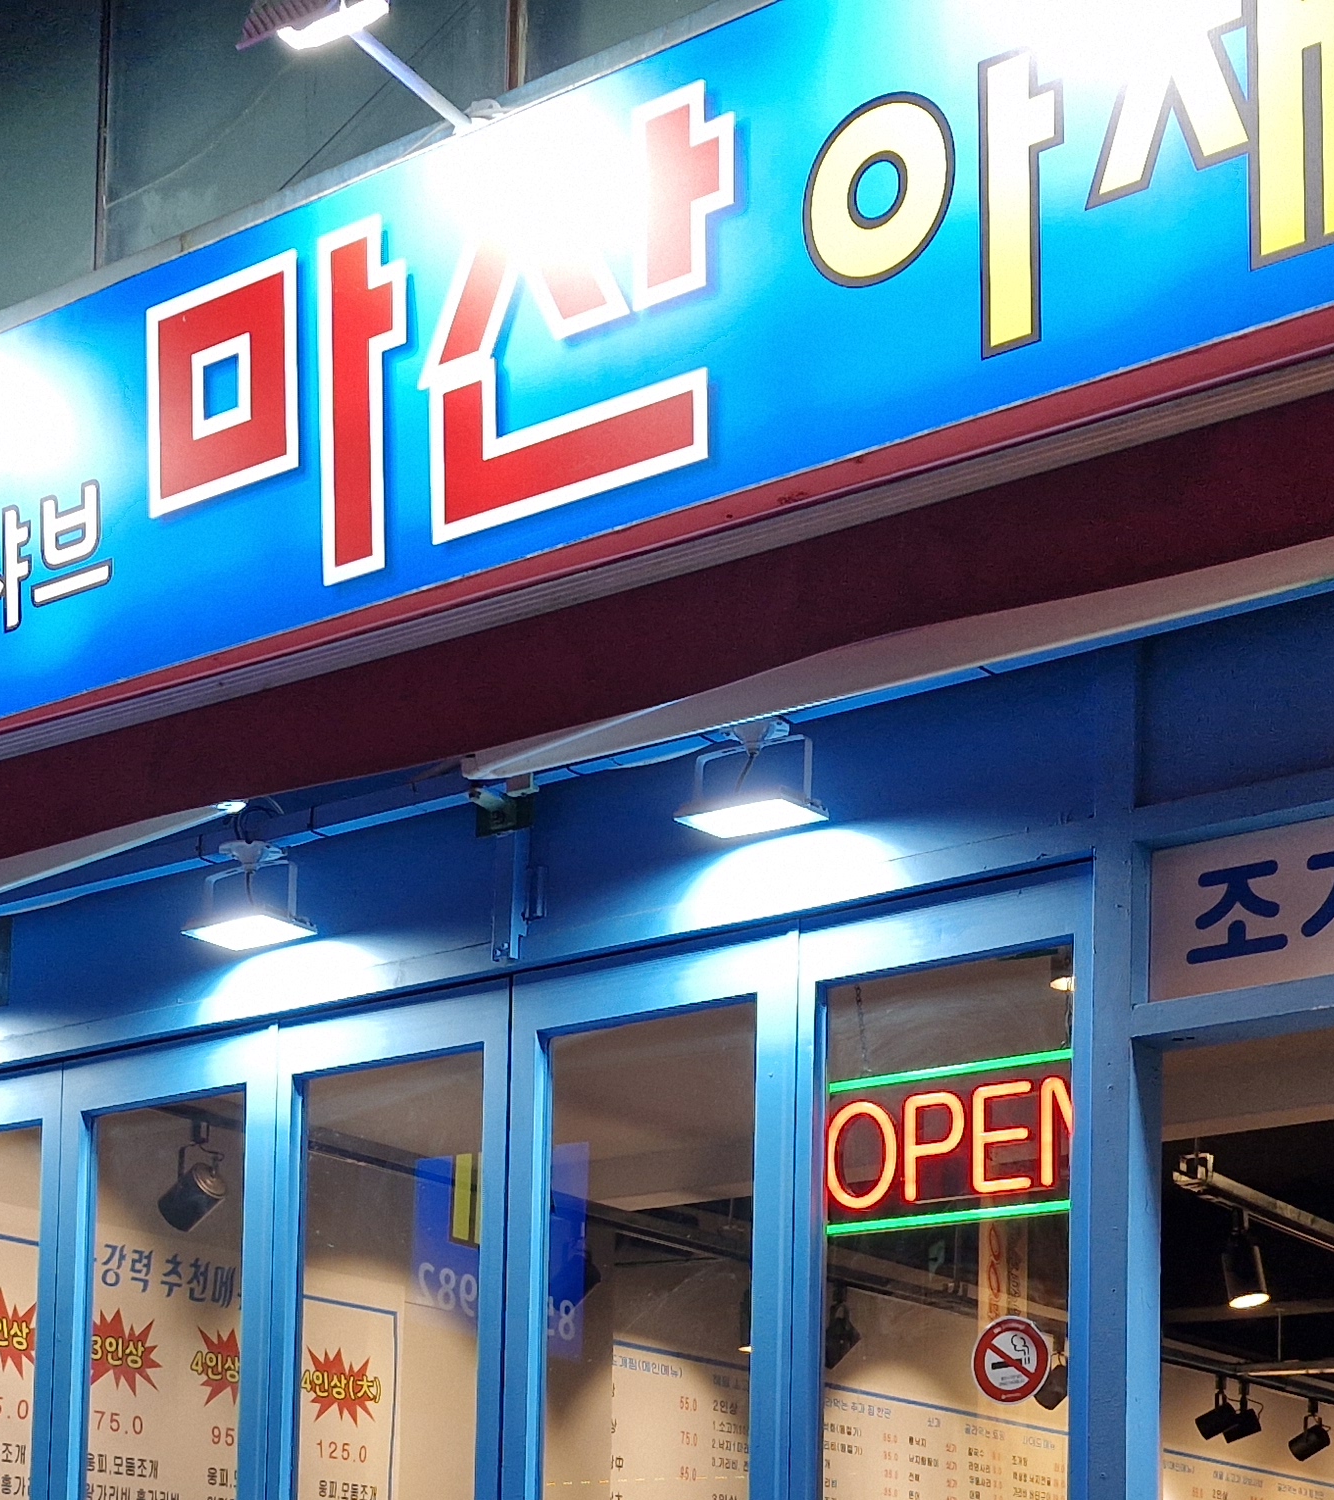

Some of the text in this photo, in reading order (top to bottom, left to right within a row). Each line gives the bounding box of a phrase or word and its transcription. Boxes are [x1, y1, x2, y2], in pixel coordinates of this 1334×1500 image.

[146, 79, 736, 587] 마산
[160, 1252, 242, 1310] 추천메
[91, 1335, 145, 1370] 3인상
